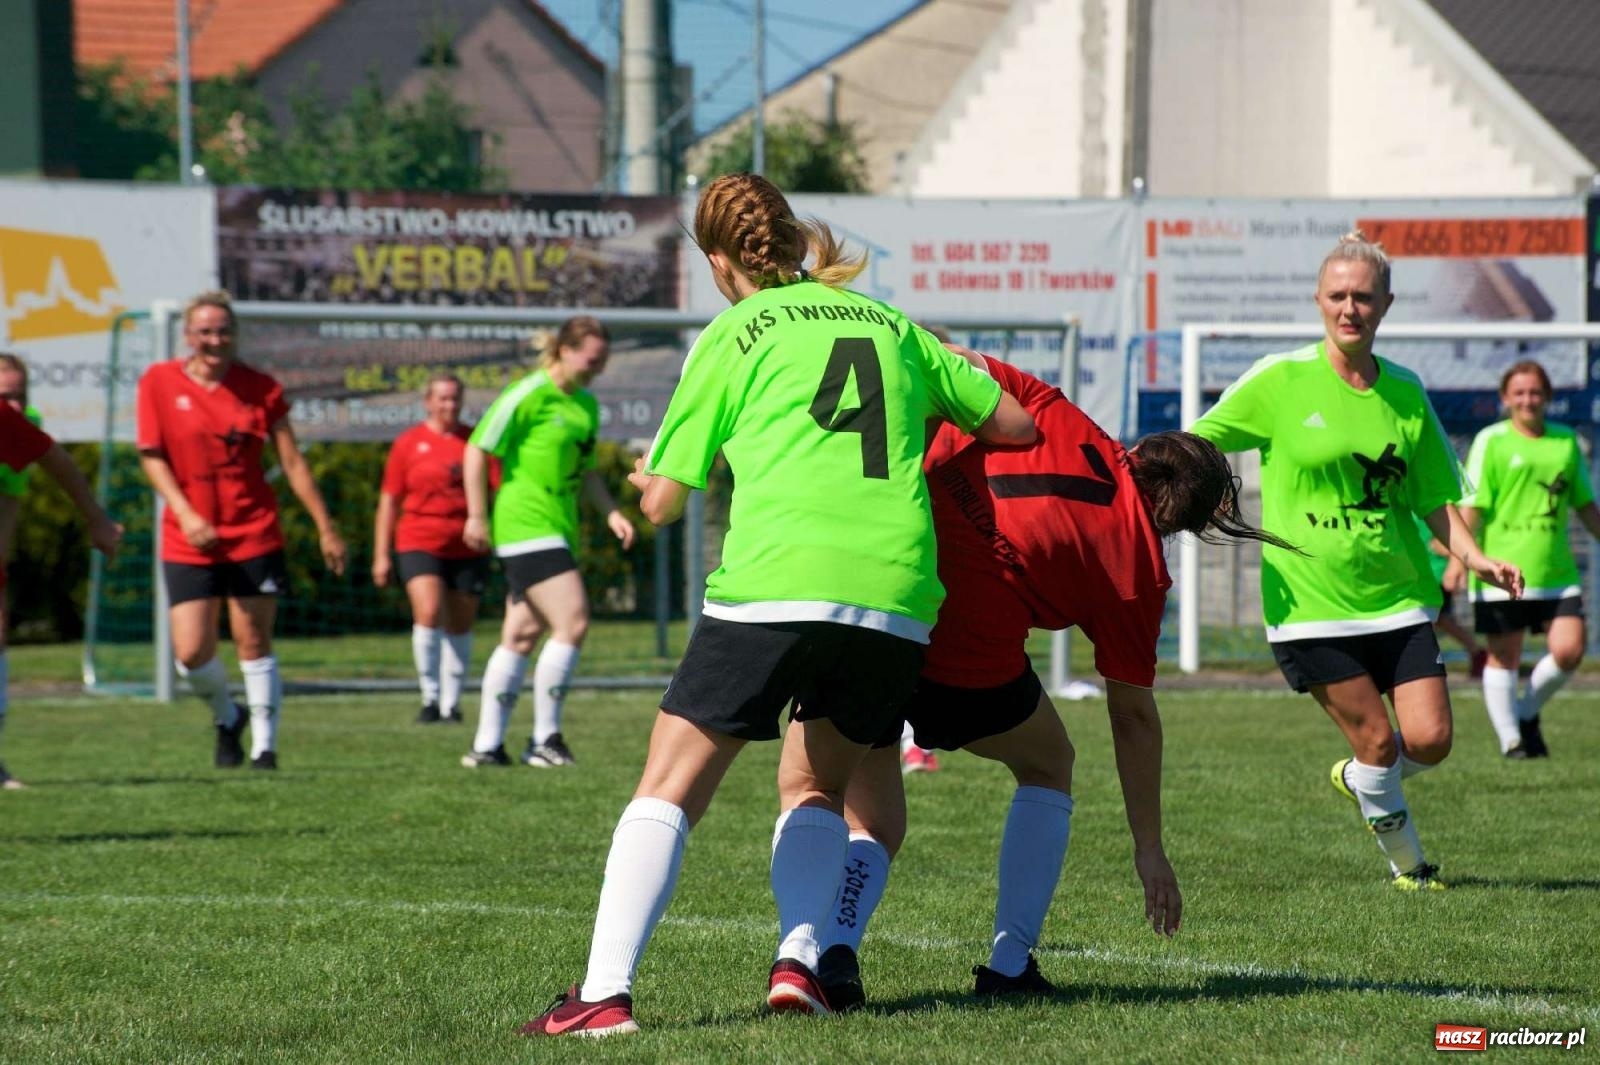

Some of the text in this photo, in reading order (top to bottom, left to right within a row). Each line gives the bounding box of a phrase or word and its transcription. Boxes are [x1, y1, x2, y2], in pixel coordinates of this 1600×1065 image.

[1403, 221, 1450, 254] 666
[1518, 219, 1571, 254] 250
[735, 305, 901, 355] LKS TWORKÓW
[808, 337, 890, 481] 4
